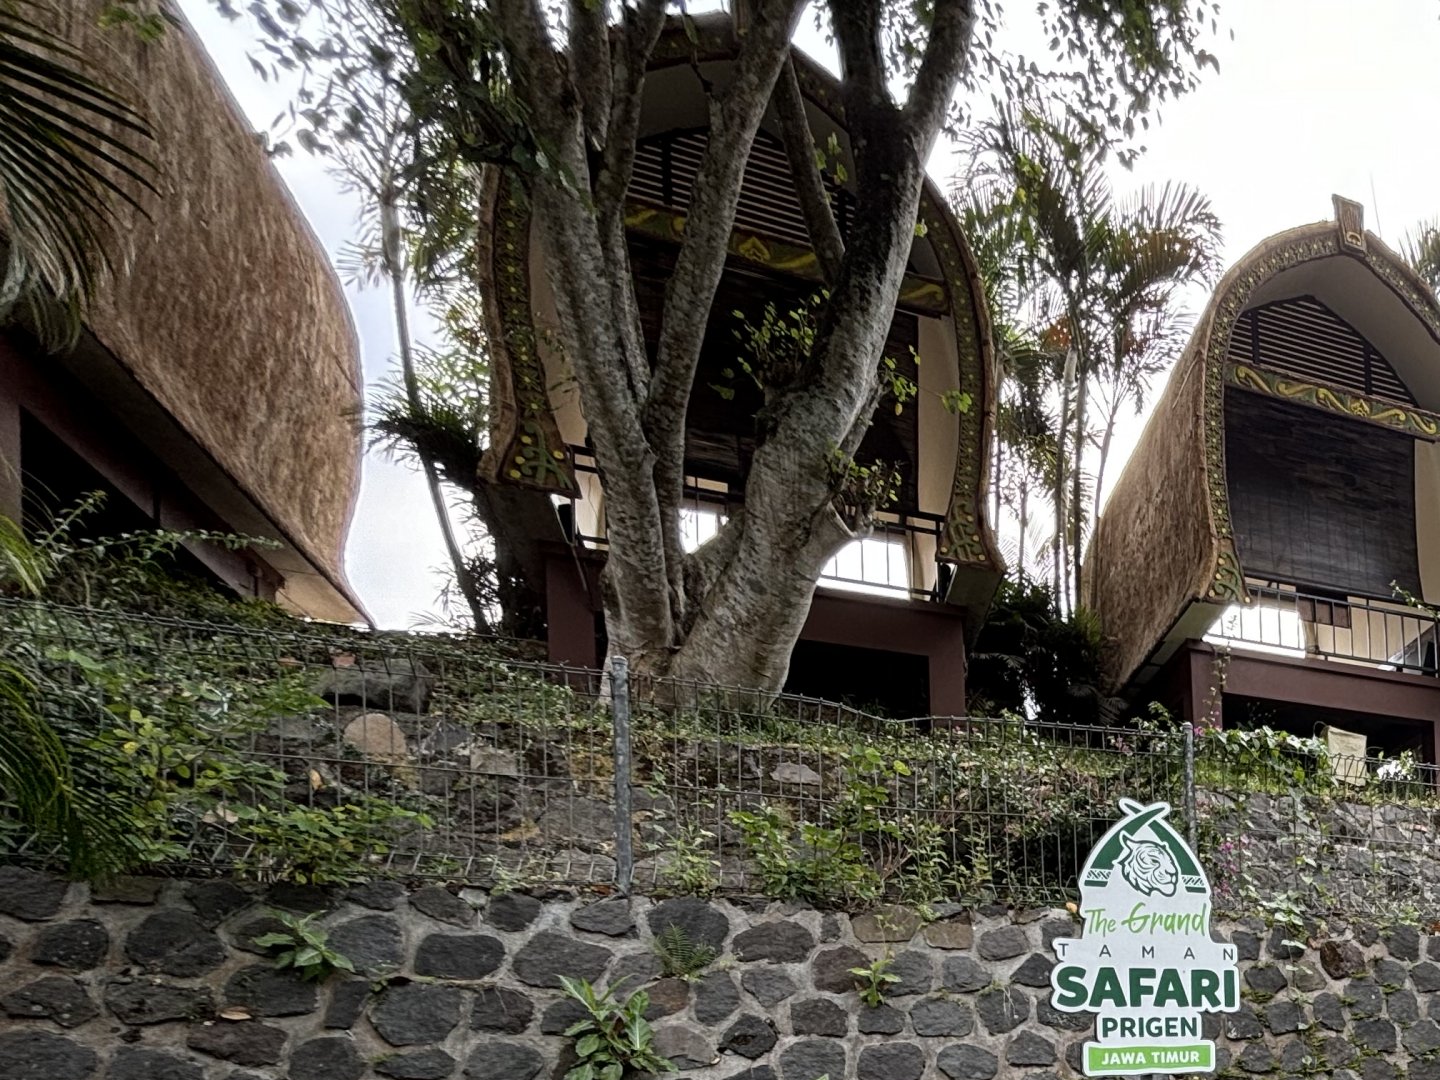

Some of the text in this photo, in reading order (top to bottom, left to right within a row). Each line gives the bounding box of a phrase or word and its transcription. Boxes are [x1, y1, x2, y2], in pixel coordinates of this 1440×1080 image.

[1085, 902, 1206, 937] The Grand
[1056, 966, 1235, 1008] SAFARI
[1102, 1017, 1197, 1037] PRIGEN
[1102, 1051, 1200, 1065] JAWA TIMUR
